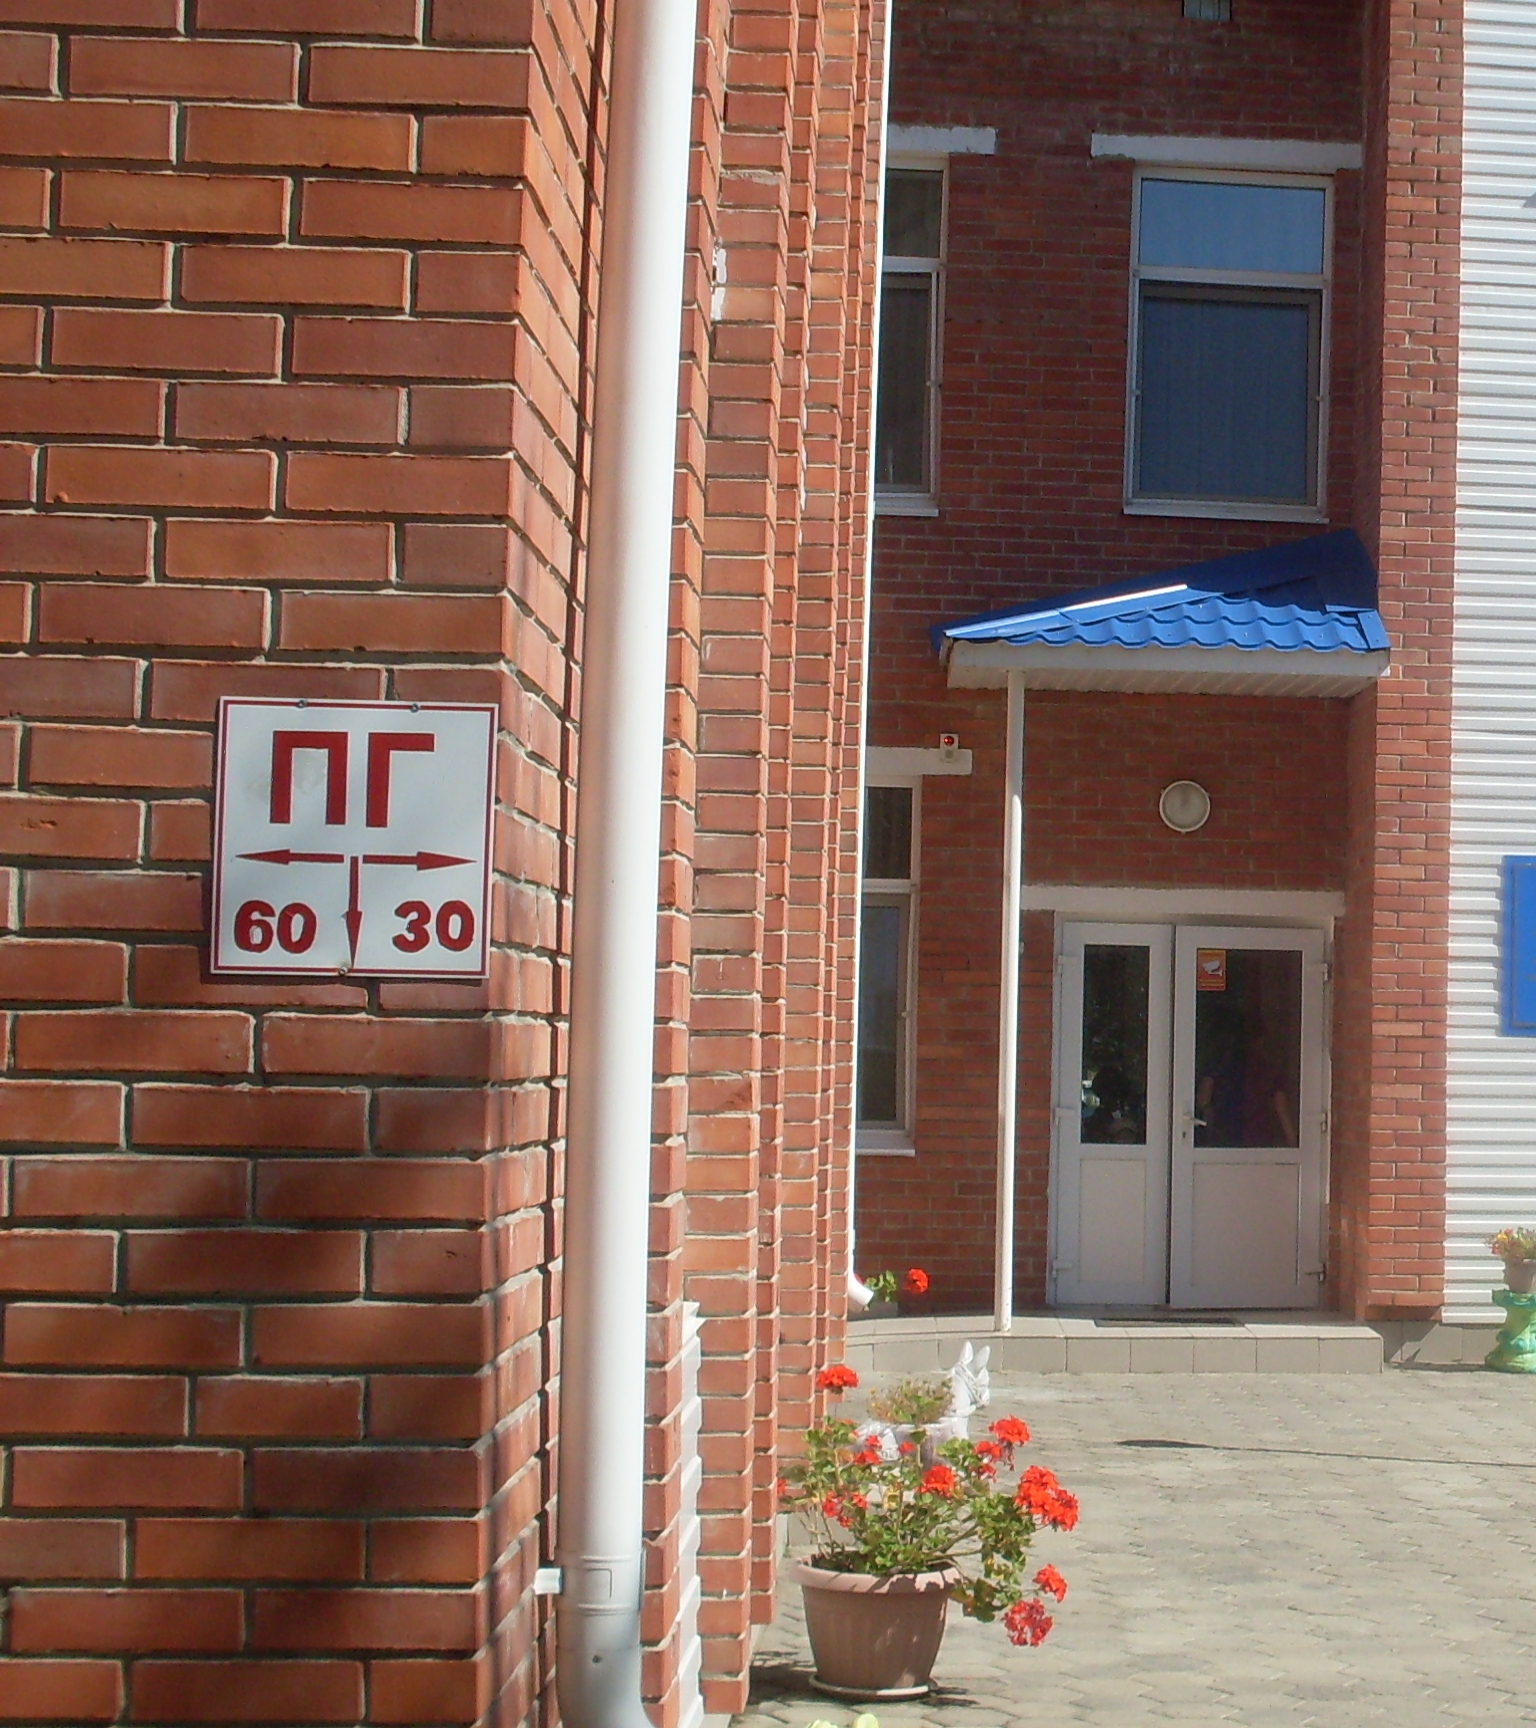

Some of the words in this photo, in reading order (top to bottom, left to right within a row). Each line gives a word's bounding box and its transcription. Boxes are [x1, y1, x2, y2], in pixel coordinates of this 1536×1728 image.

[269, 730, 435, 828] ПГ
[233, 899, 318, 954] 60
[391, 899, 476, 953] 30
